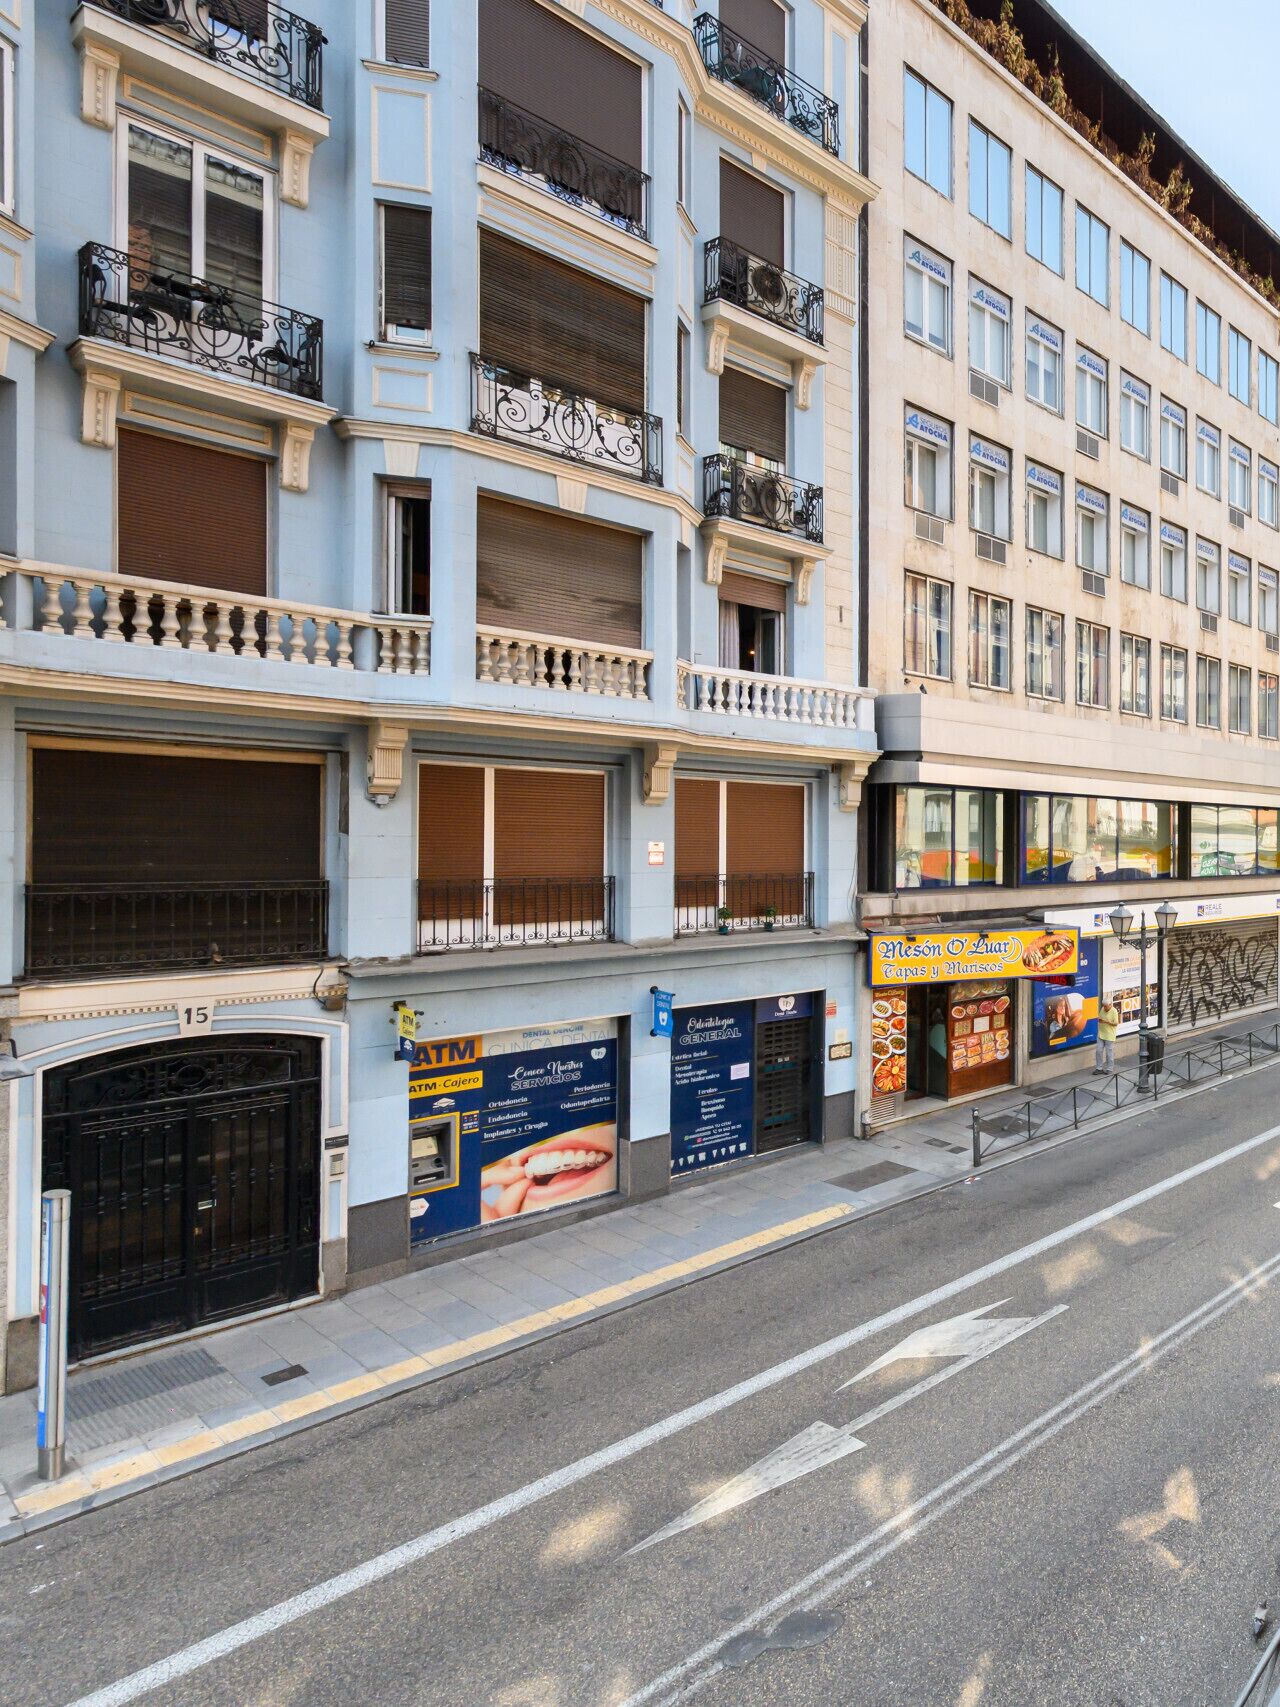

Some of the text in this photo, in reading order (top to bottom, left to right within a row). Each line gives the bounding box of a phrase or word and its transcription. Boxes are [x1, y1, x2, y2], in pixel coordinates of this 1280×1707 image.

[921, 261, 946, 279] ATOCHA
[984, 299, 1007, 316] ATOCHA
[1040, 332, 1059, 348] ATOCHA
[920, 417, 948, 435] SEGUROS
[920, 424, 948, 442] ATOCHA
[981, 451, 1007, 468] ATOCHA
[1036, 476, 1059, 491] ATOCHA
[1085, 497, 1105, 511] ATOCHA
[877, 938, 942, 962] Mesón
[881, 961, 1004, 982] Tapas y Mariscos
[184, 1007, 209, 1025] 15
[403, 1014, 414, 1026] ATM
[523, 1030, 551, 1039] DENTAL
[679, 1027, 742, 1046] GENERAL
[414, 1039, 475, 1066] ATM
[508, 1060, 584, 1080] Conoce Nuestros
[409, 1075, 480, 1094] ATM Cajero
[511, 1070, 582, 1092] SERVICIOS
[573, 1081, 611, 1093] Periodoncia
[488, 1096, 529, 1109] Ortodoncia
[488, 1110, 529, 1123] Endodoncia
[483, 1127, 517, 1139] Implantes
[518, 1126, 523, 1134] y
